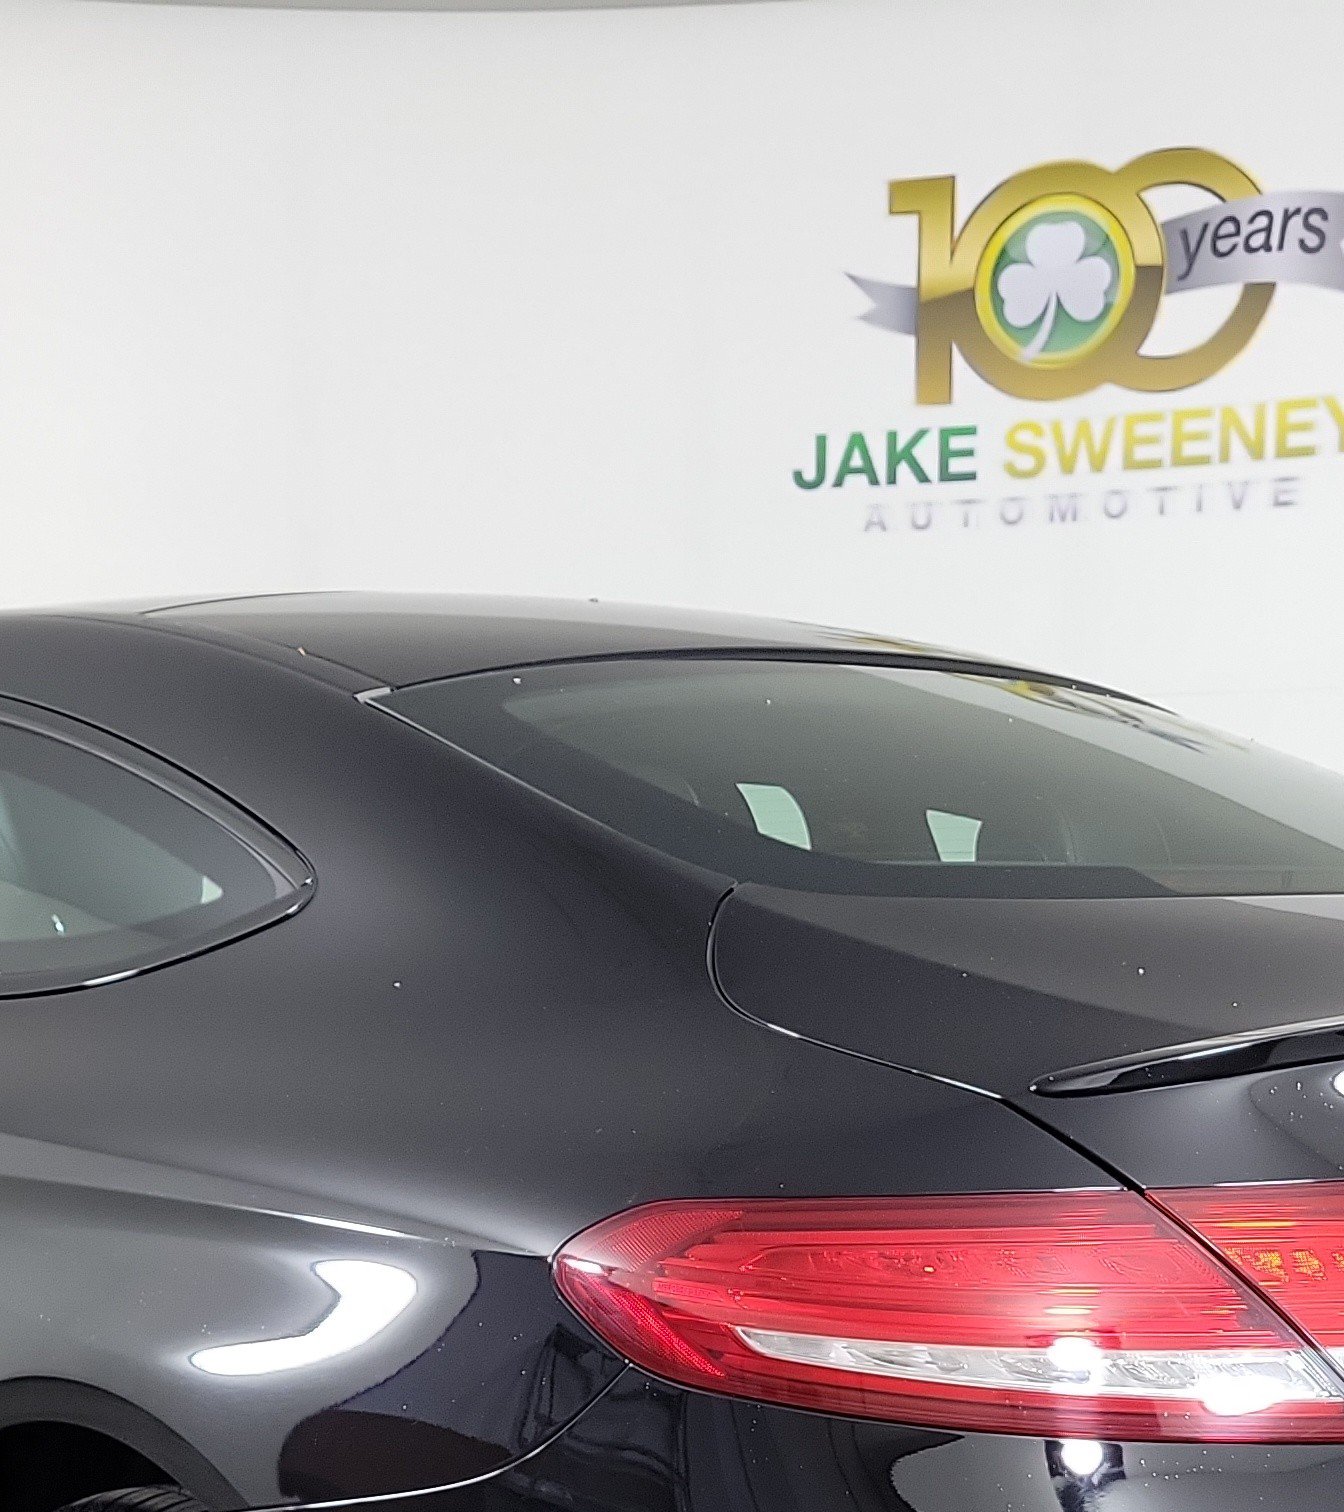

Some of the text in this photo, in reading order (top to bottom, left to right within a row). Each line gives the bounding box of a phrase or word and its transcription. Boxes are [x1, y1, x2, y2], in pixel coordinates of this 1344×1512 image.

[888, 146, 1331, 406] 100 years
[792, 424, 978, 491] JAKE
[861, 476, 1303, 534] AUTOMOTIVE
